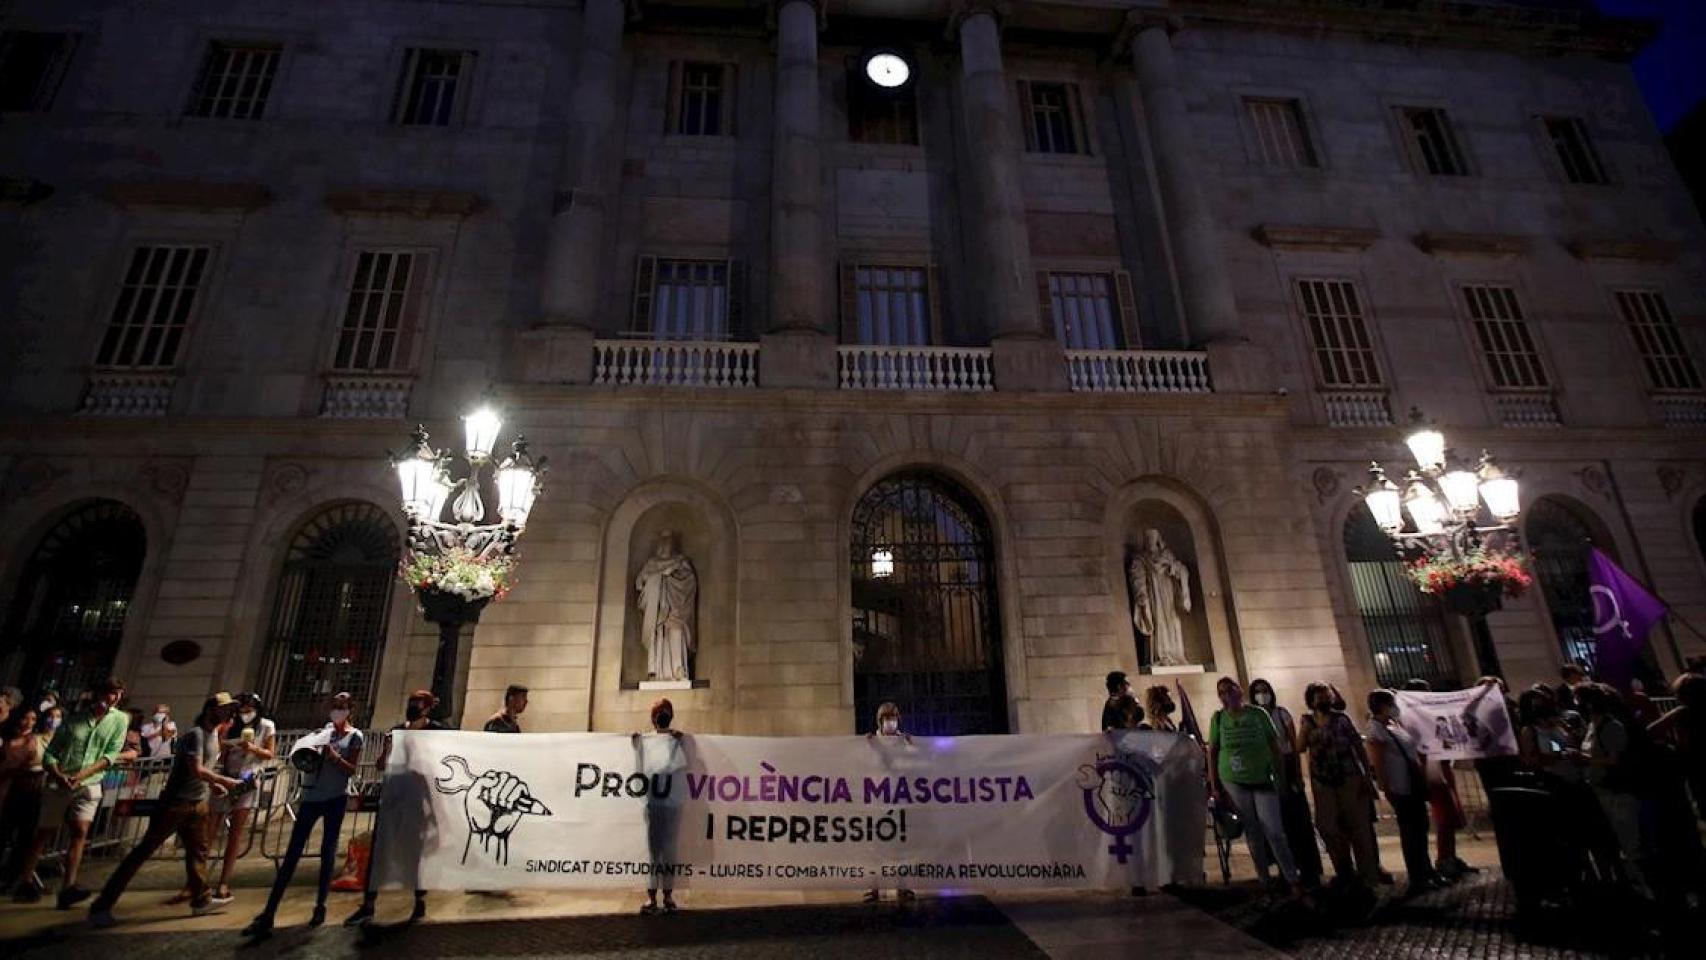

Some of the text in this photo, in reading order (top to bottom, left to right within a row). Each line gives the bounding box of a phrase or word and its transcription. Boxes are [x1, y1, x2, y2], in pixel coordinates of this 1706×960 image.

[574, 760, 1035, 805] PROU VIOLÈNCIA MASCLISTA
[706, 809, 908, 844] I REPRESSIÓ!
[526, 859, 590, 874] SINDICAT
[593, 860, 693, 877] D'ESTUDIANTS
[710, 864, 764, 878] LLIURES
[767, 865, 772, 877] I
[775, 865, 865, 879] COMBATIVES
[881, 863, 956, 879] ESQUERRA
[959, 861, 1086, 879] REVOLUCIONÀRIA
